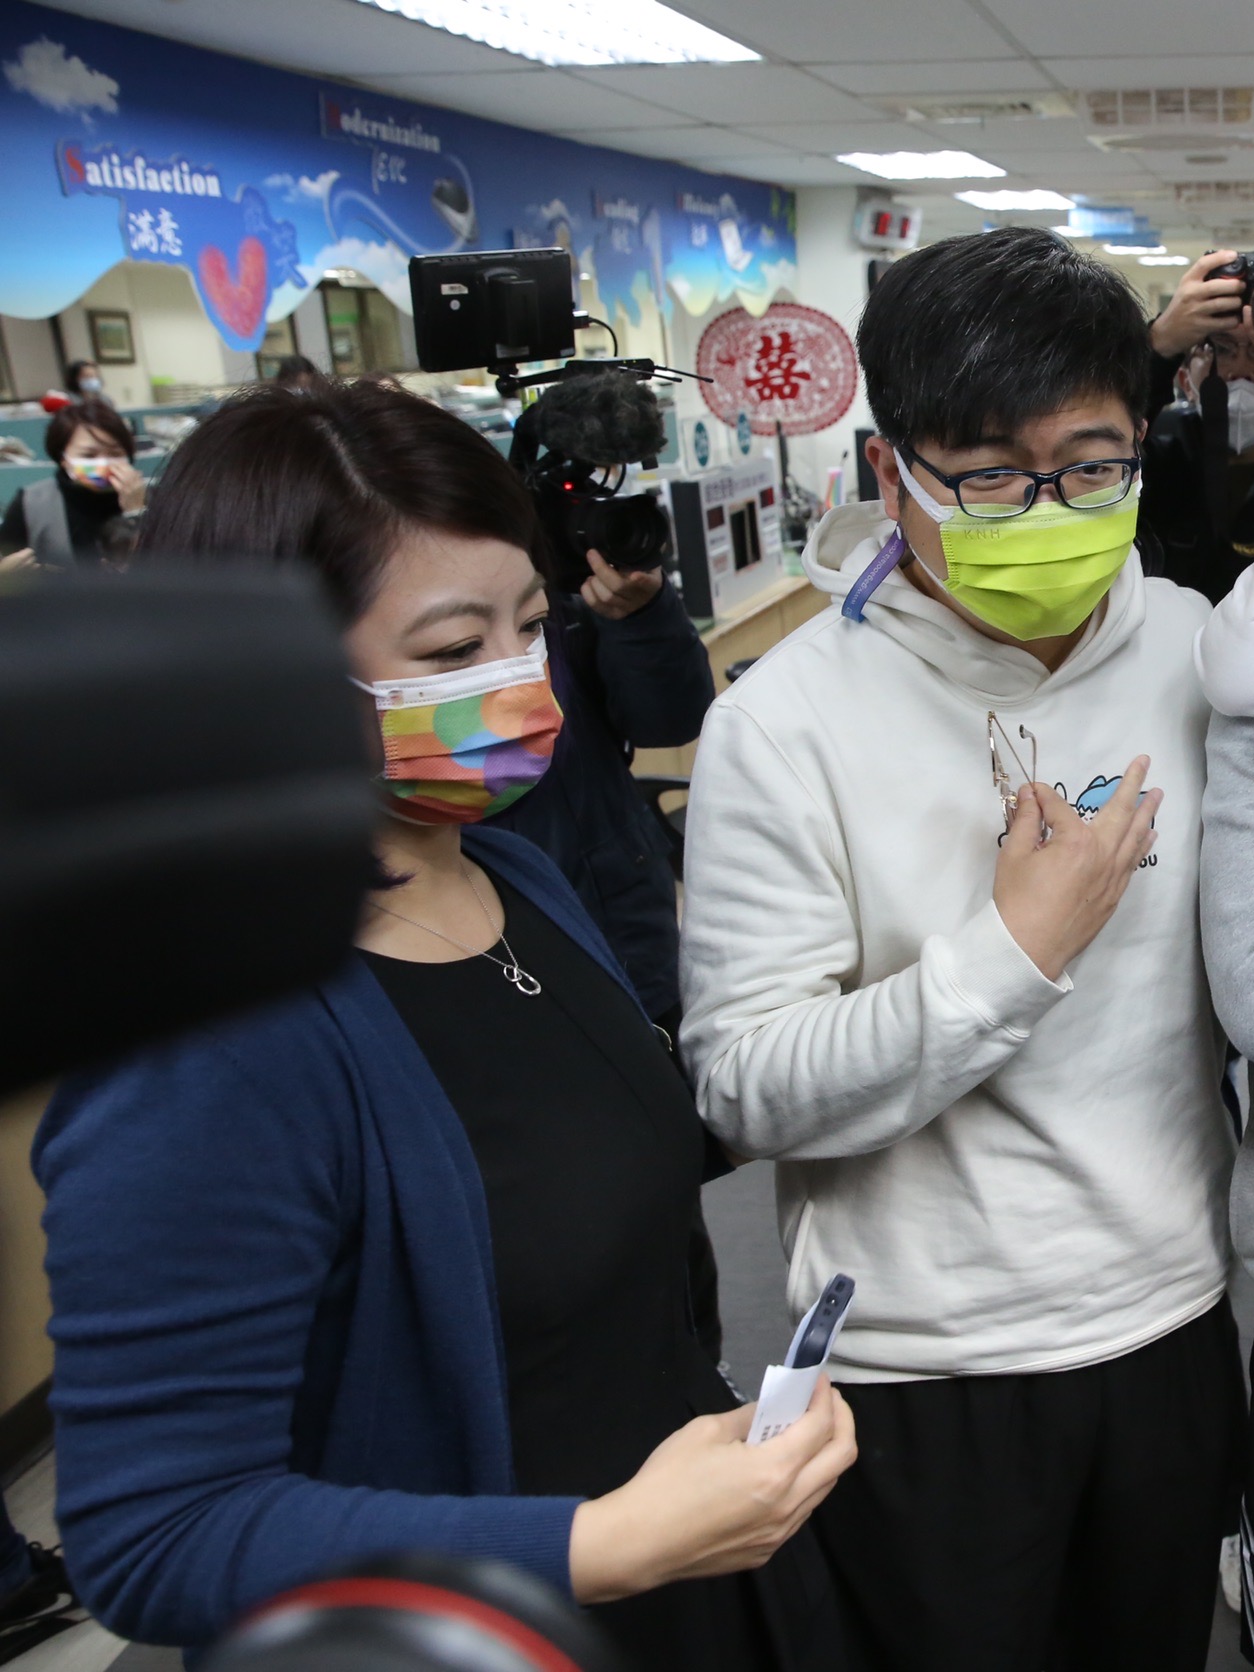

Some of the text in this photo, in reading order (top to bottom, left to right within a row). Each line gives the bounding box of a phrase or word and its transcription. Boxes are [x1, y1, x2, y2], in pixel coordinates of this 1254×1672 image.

[65, 147, 222, 198] Satisfaction
[963, 528, 1001, 540] KNH
[1134, 854, 1158, 871] OU
